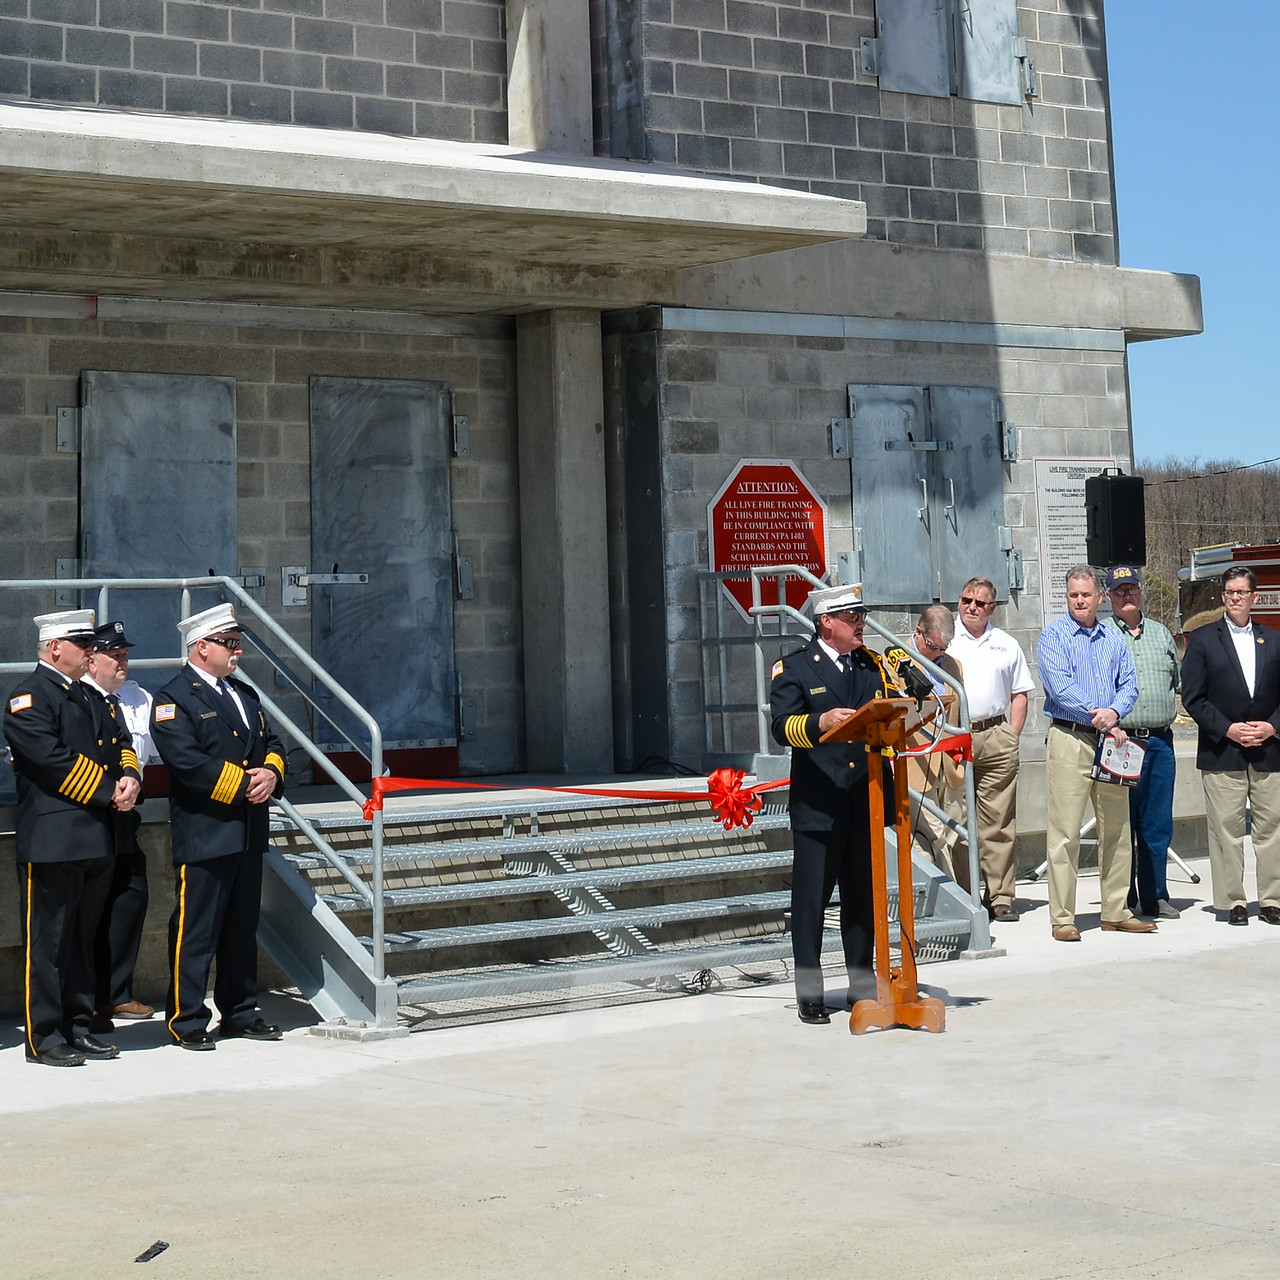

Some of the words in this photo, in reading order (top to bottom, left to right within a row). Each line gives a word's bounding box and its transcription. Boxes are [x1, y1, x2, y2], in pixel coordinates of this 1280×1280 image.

[737, 481, 799, 494] ATTENTION:
[723, 501, 738, 509] ALL
[740, 501, 756, 509] LIVE
[758, 501, 776, 509] FIRE
[777, 501, 813, 509] TRAINING
[791, 511, 811, 519] MUST
[723, 522, 733, 530] BE
[744, 522, 793, 530] COMPLIANCE
[795, 521, 815, 529] WITH
[734, 532, 769, 540] CURRENT
[770, 532, 789, 540] NFPA
[731, 543, 775, 551] STANDARDS
[777, 542, 791, 550] AND
[793, 542, 808, 550] THE
[730, 553, 779, 562] SCHUYLKILL
[780, 553, 810, 561] COUNTY
